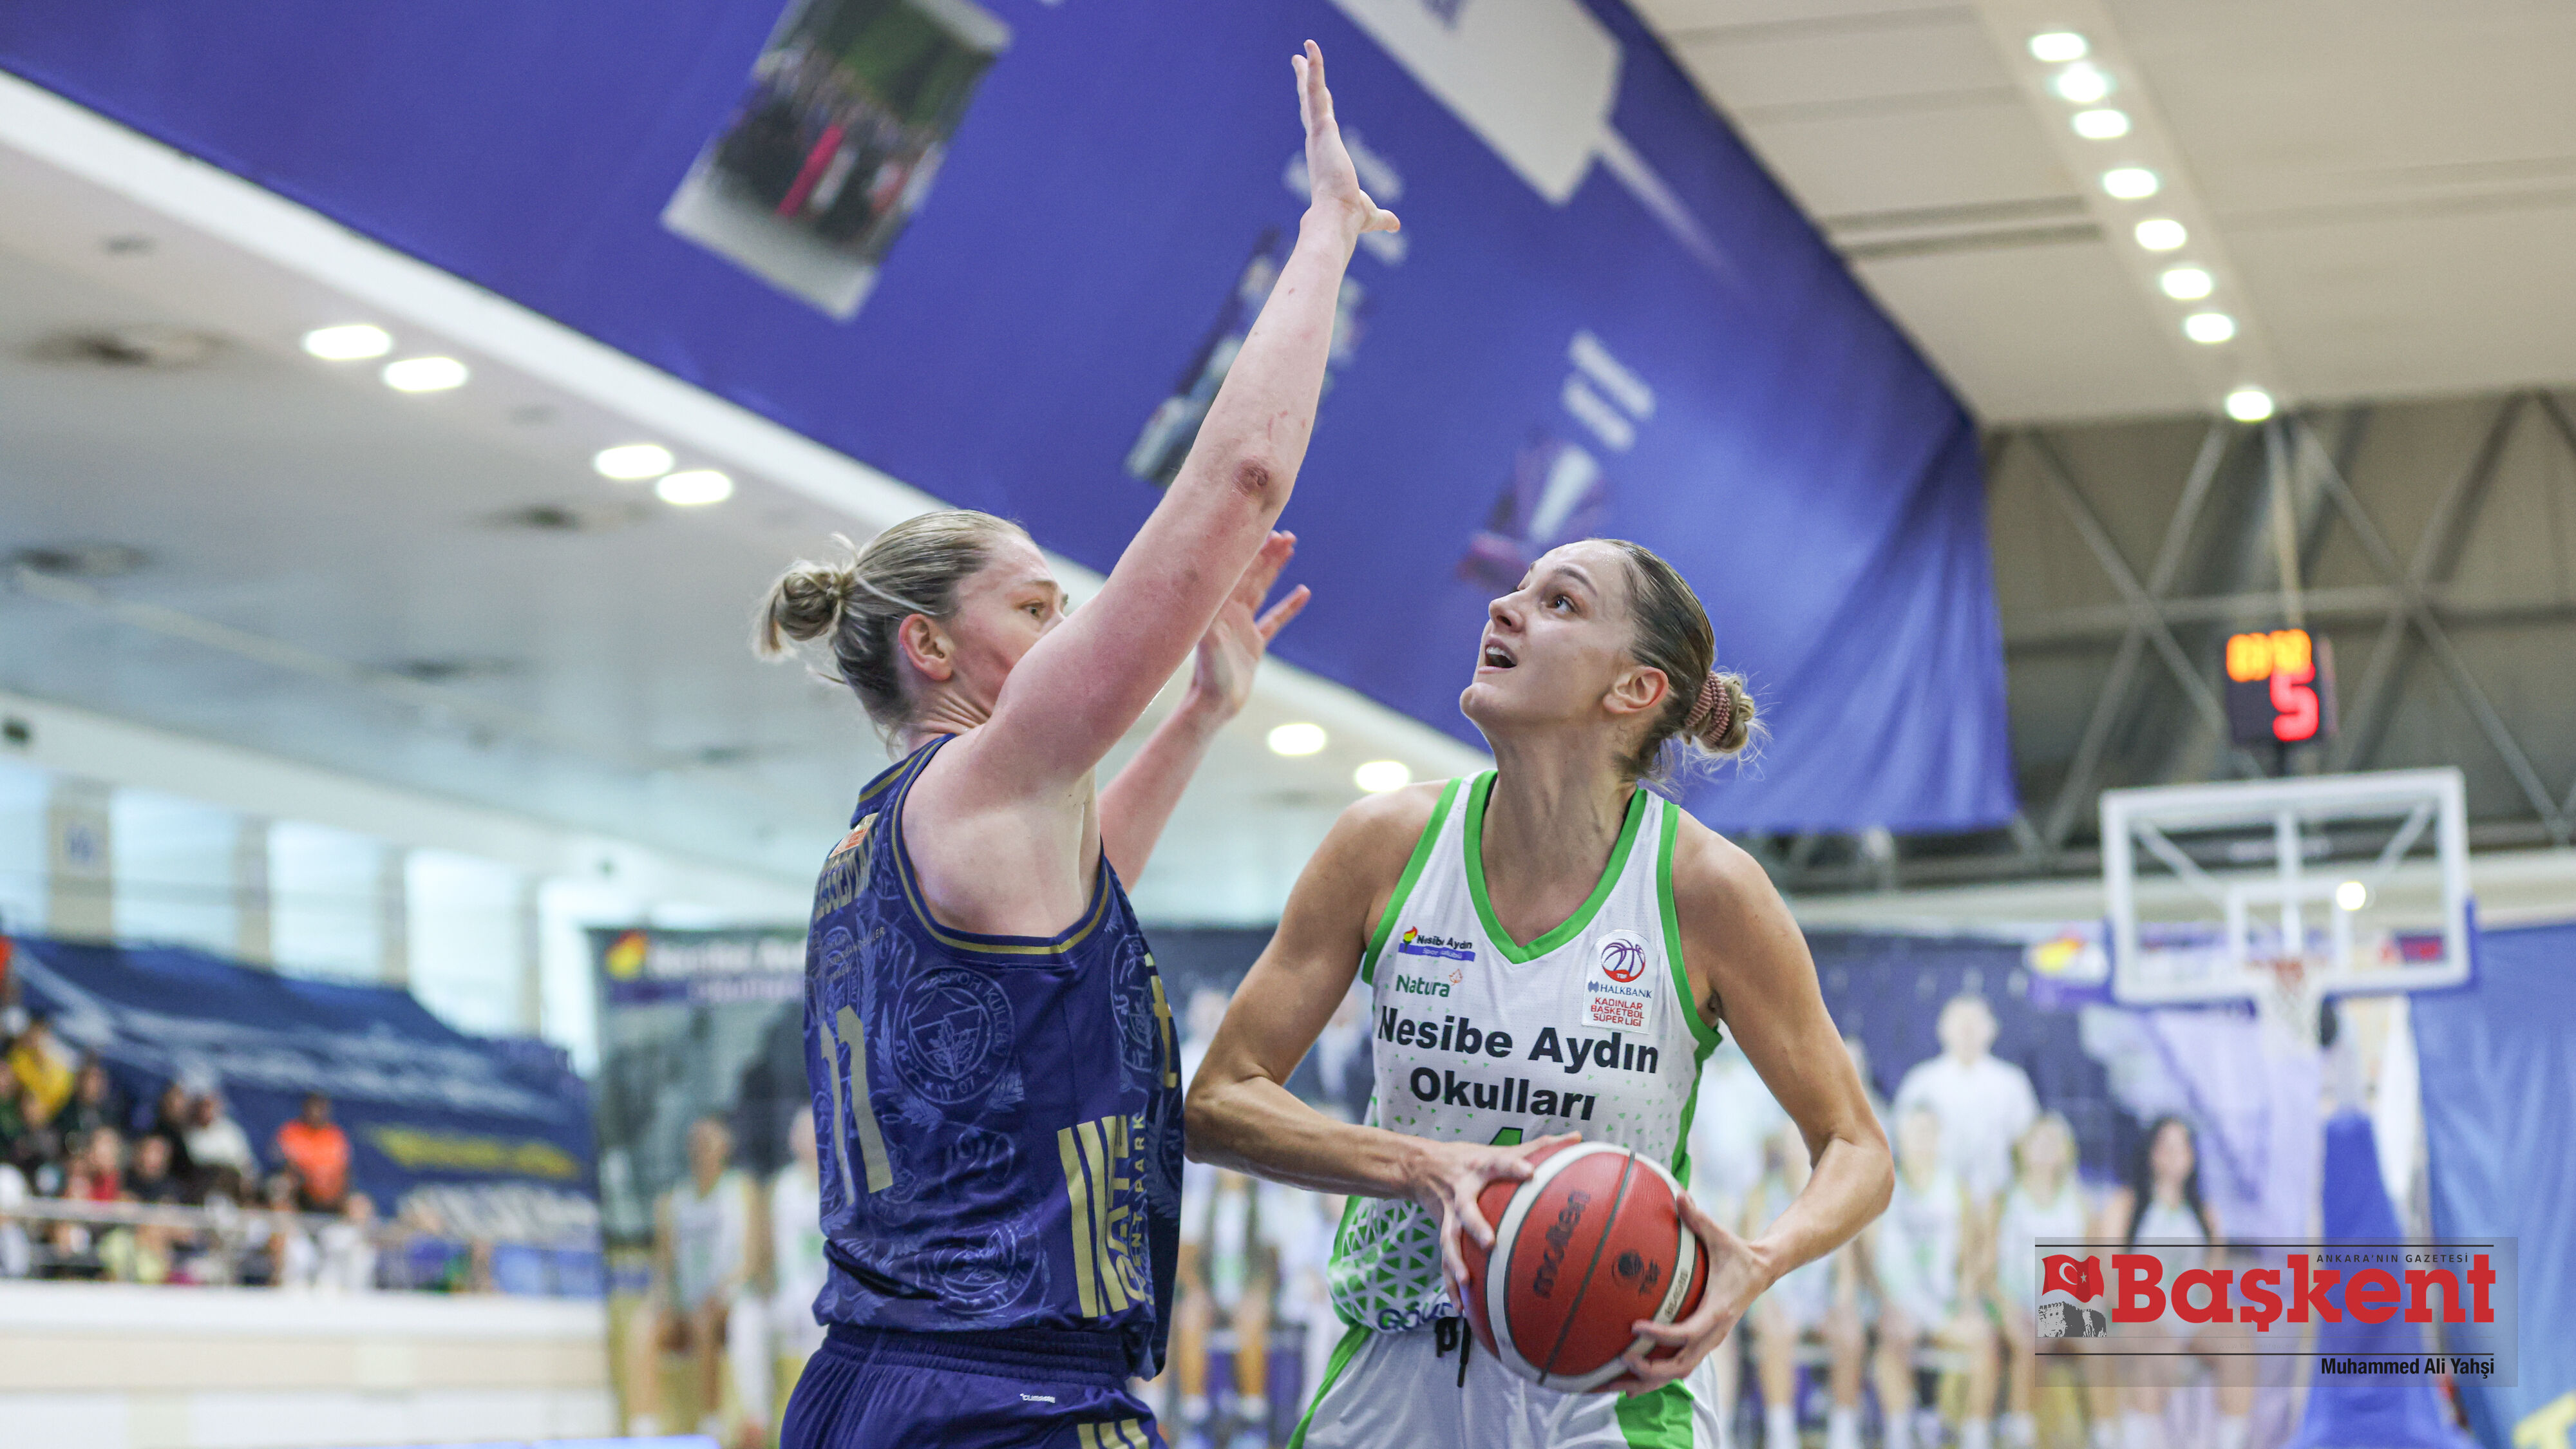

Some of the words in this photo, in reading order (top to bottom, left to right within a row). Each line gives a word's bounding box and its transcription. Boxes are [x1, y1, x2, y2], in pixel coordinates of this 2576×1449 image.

[1396, 974, 1450, 997] Natura
[1600, 984, 1652, 998] HALKBANK
[1591, 1005, 1644, 1019] BASKETBOL
[1595, 998, 1643, 1010] KADINLAR
[1593, 1013, 1624, 1024] SÜPER
[1378, 1006, 1513, 1057] Nesibe
[1528, 1027, 1658, 1074] Aydın
[1410, 1067, 1596, 1121] Okulları
[1132, 1116, 1144, 1192] PARK
